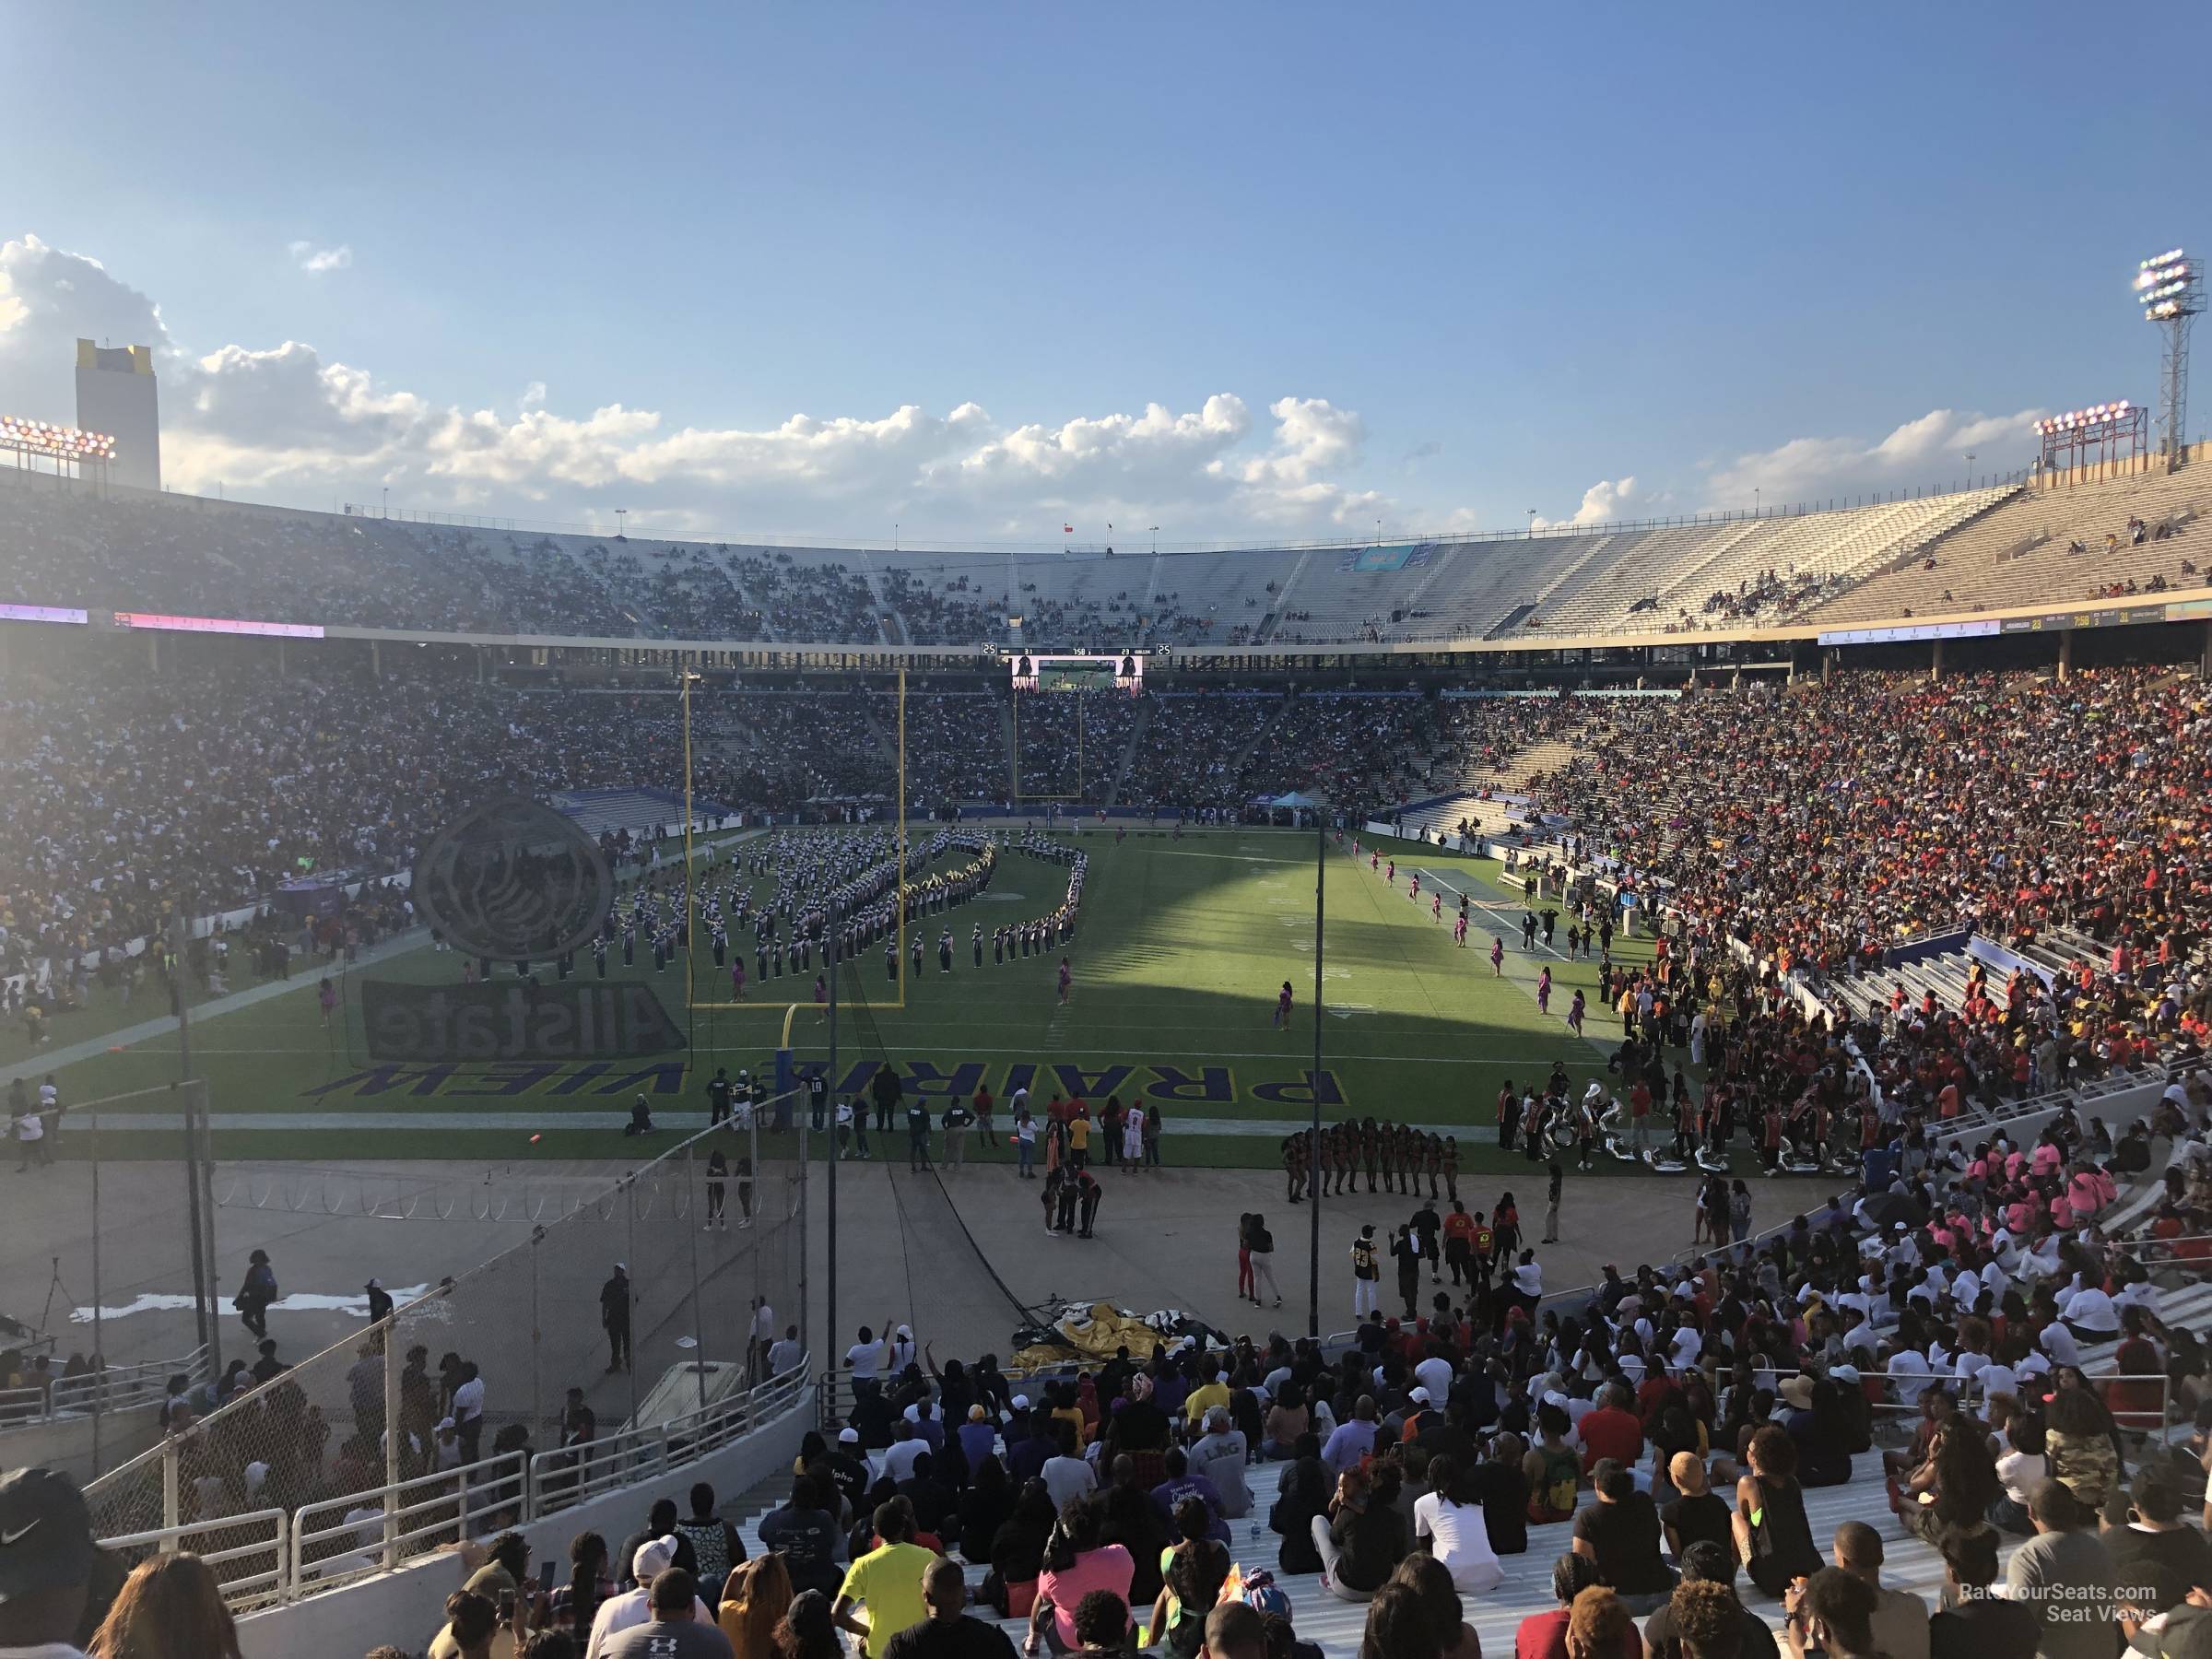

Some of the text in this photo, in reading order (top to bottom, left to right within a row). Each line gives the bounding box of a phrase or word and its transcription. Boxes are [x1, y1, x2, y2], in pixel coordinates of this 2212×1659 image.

[983, 644, 995, 654] 25
[1159, 645, 1171, 655] 25
[297, 1061, 690, 1097] VIEW
